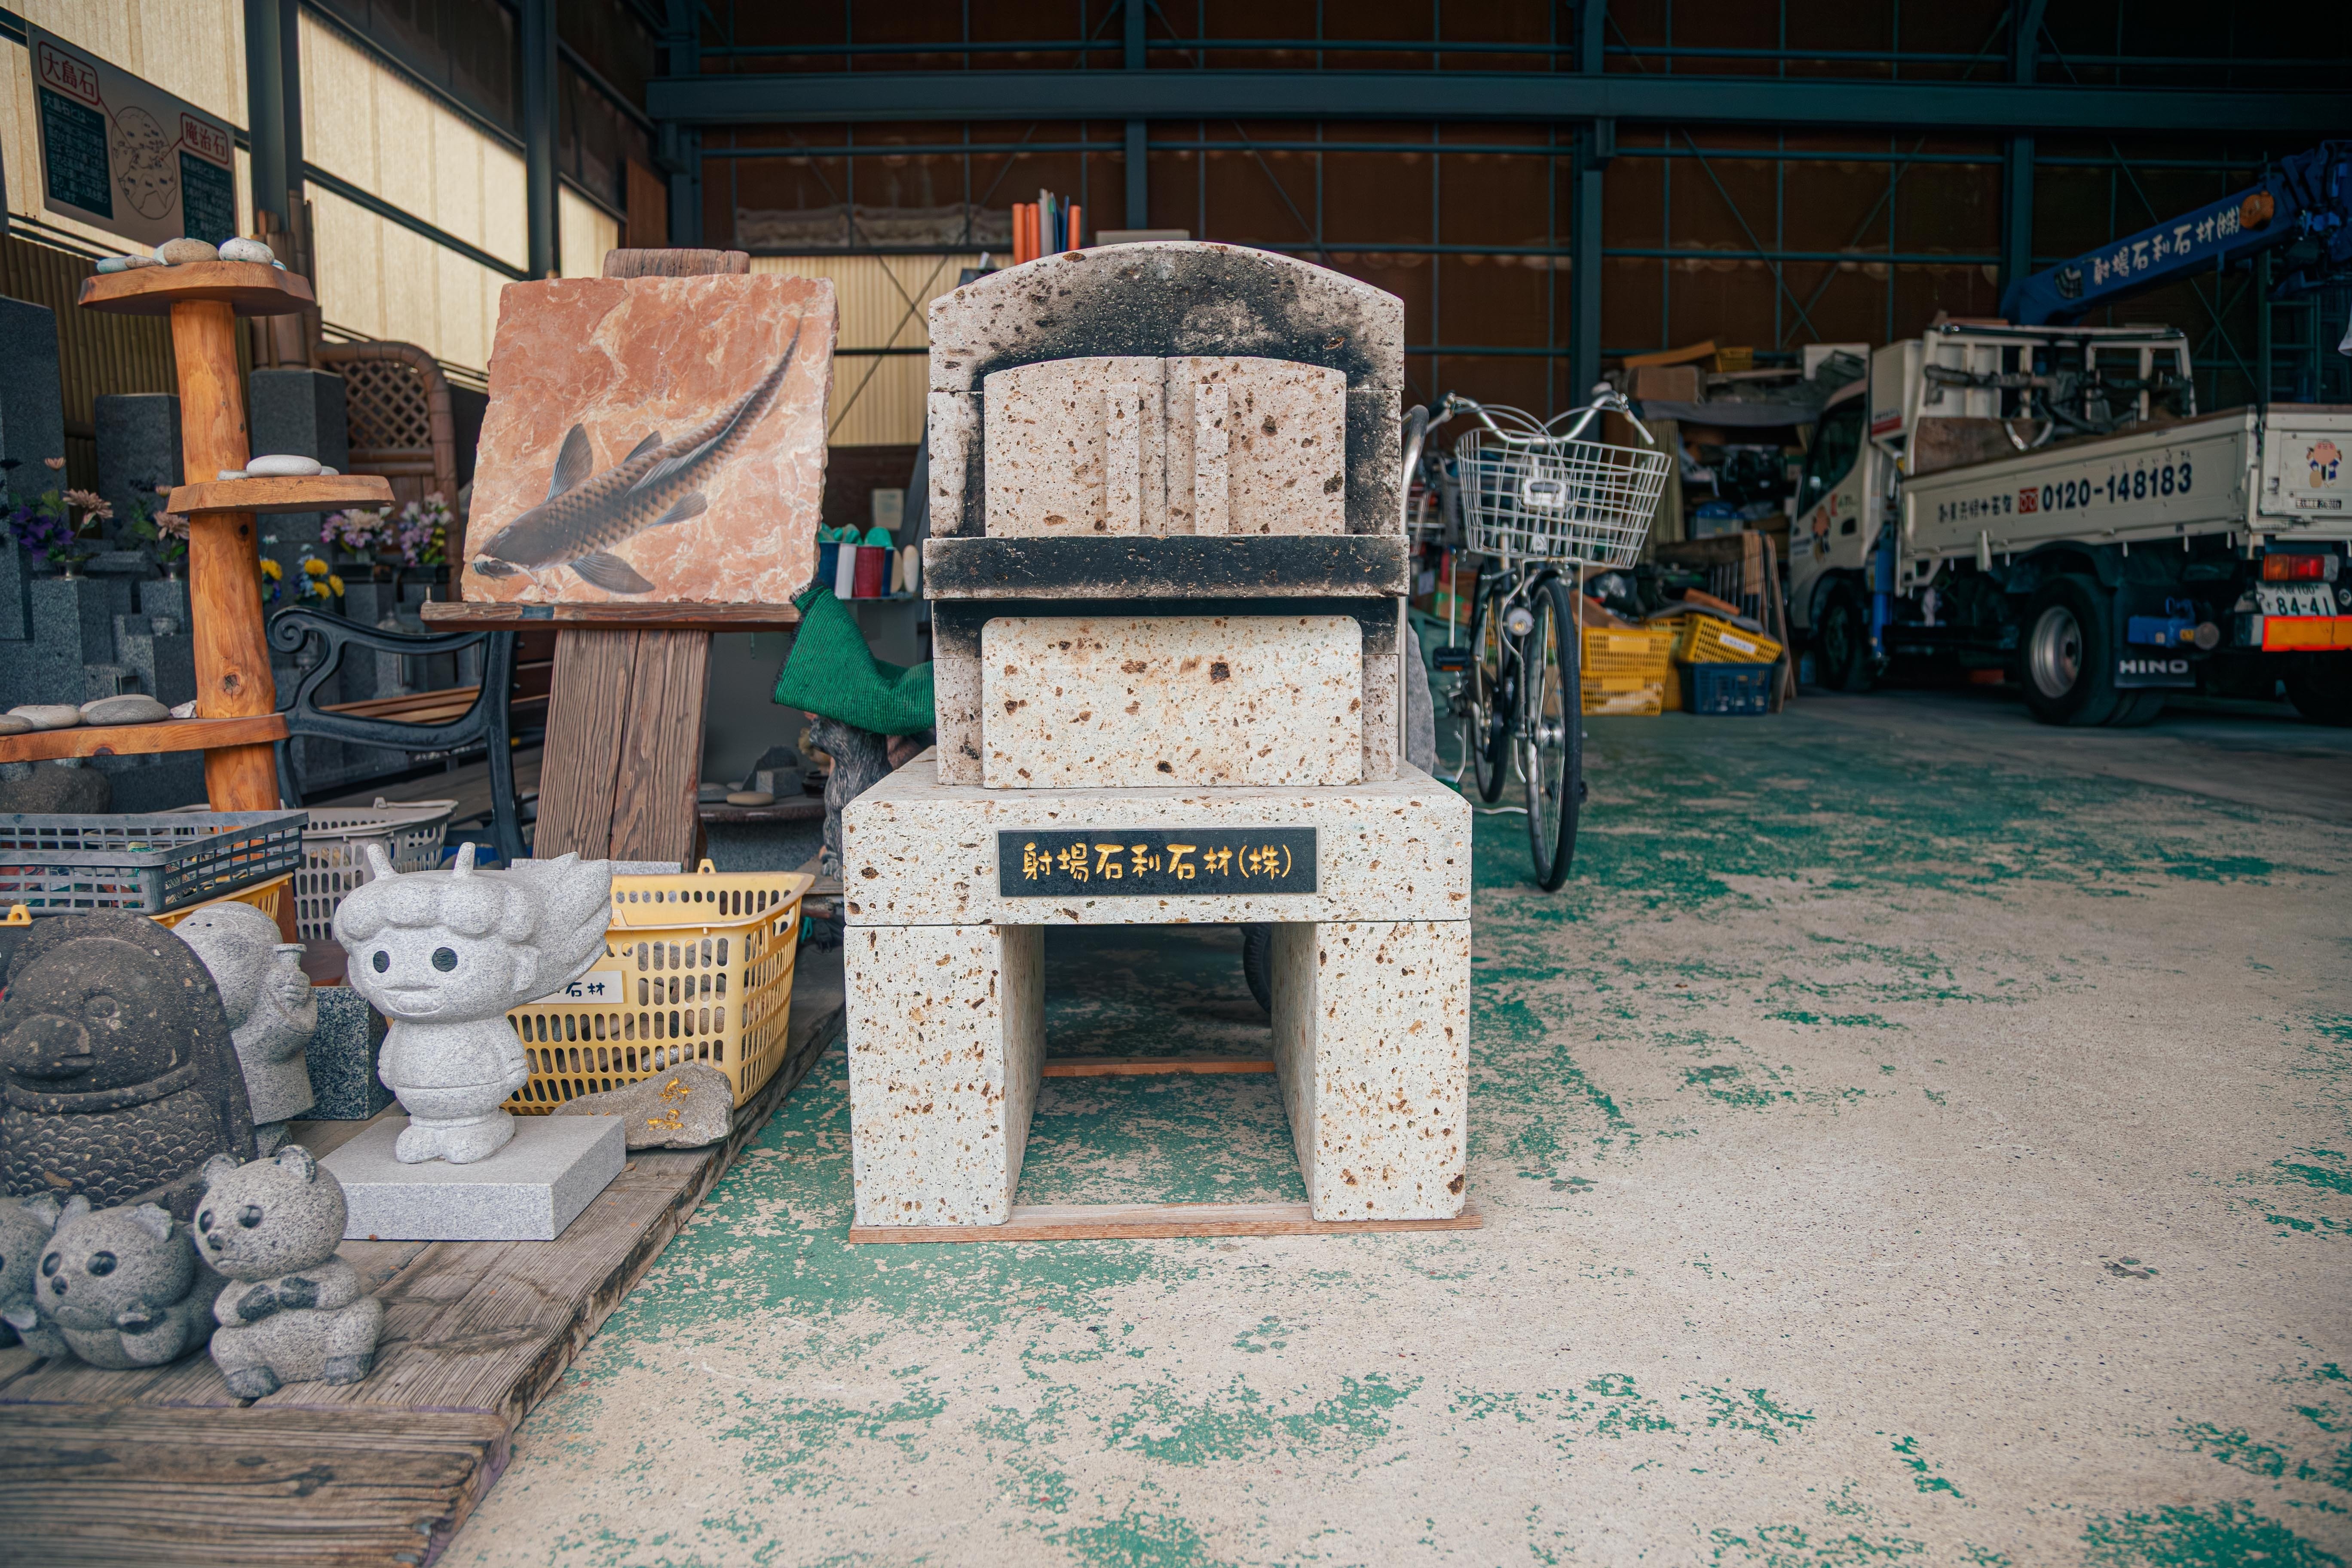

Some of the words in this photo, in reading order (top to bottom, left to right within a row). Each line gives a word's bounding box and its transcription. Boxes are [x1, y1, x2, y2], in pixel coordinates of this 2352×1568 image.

[44, 51, 94, 97] 大島石
[2042, 462, 2192, 511] 0120-148183
[2119, 658, 2188, 674] HINO
[1022, 842, 1292, 883] 射場石利石材(株)
[557, 982, 605, 997] 石材
